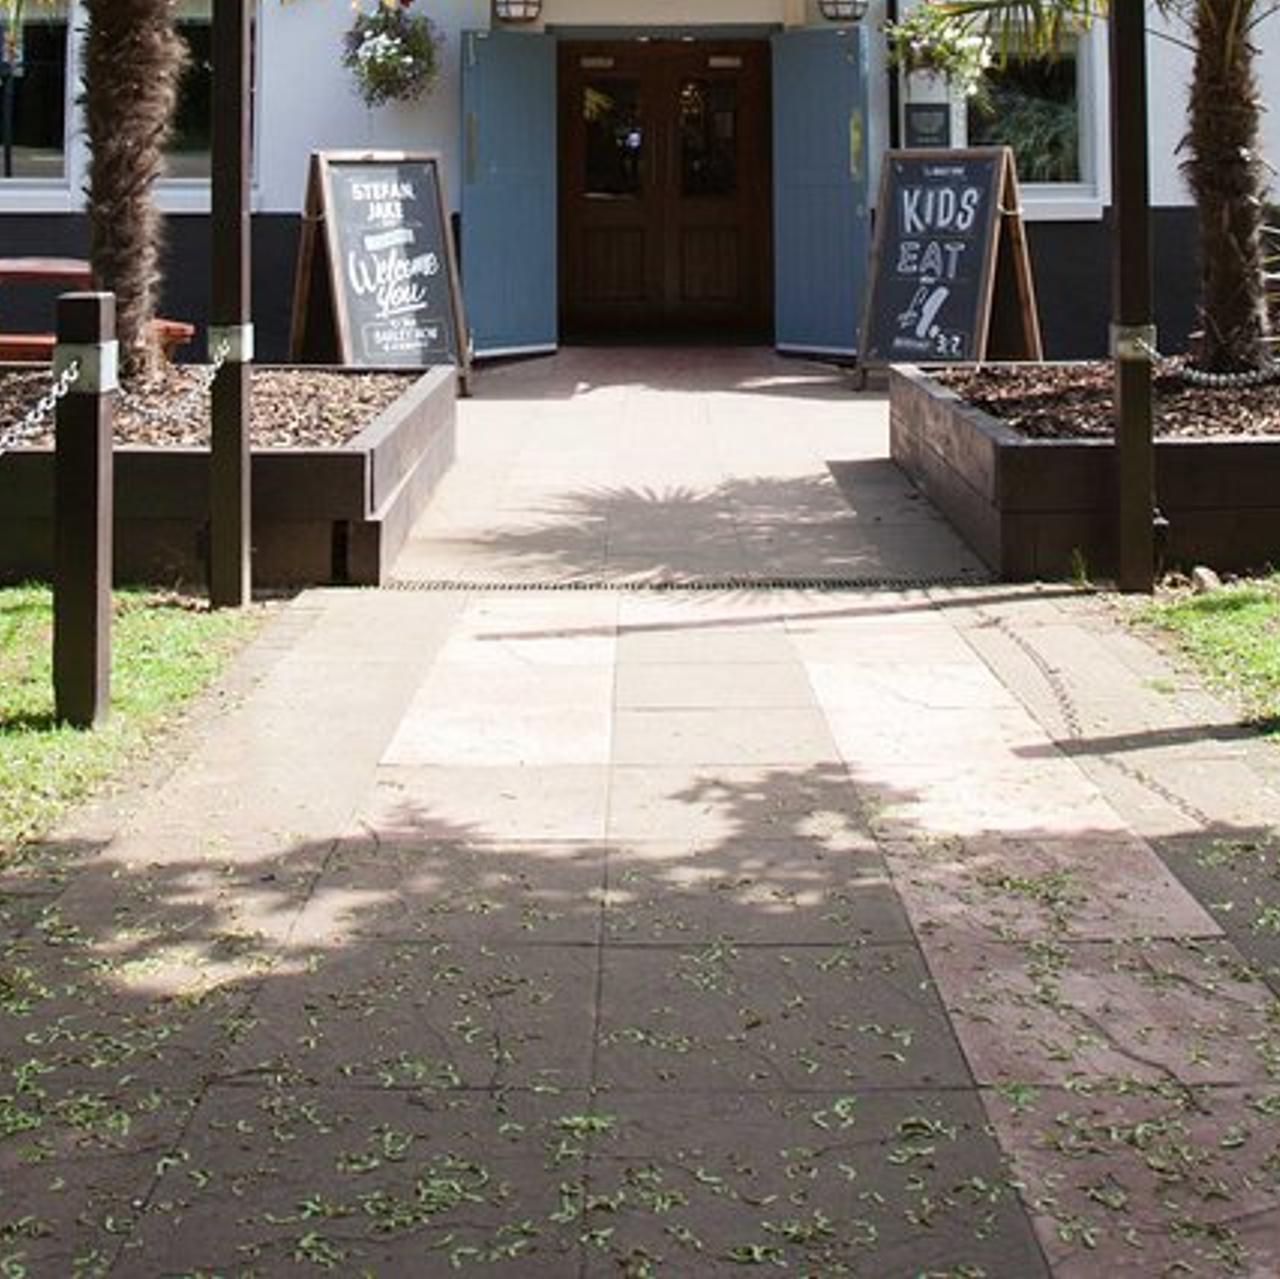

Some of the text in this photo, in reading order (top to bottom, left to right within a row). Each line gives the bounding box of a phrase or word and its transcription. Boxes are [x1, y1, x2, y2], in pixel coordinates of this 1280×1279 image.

[903, 188, 979, 233] KIDS
[347, 247, 439, 296] Welcome
[897, 241, 965, 278] EAT
